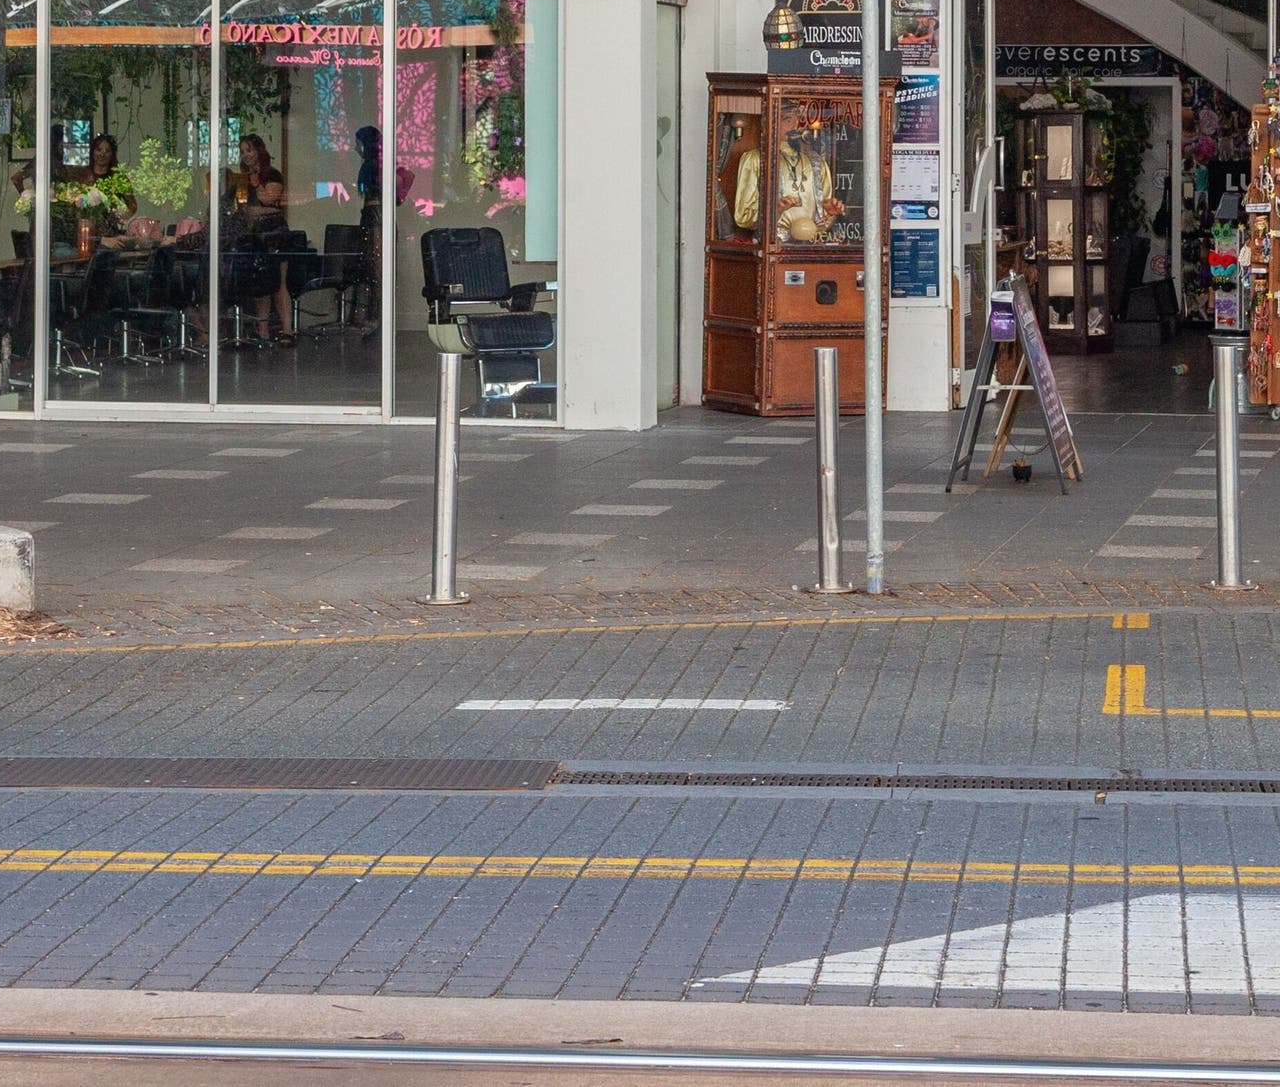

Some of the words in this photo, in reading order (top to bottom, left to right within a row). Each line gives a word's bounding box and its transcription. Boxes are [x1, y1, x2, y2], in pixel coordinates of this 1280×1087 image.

[803, 26, 863, 43] AIRDRESSIN
[810, 49, 861, 66] Chameleon
[995, 46, 1141, 62] everescents
[894, 90, 938, 103] READINGS
[896, 84, 935, 97] PSYCHIC
